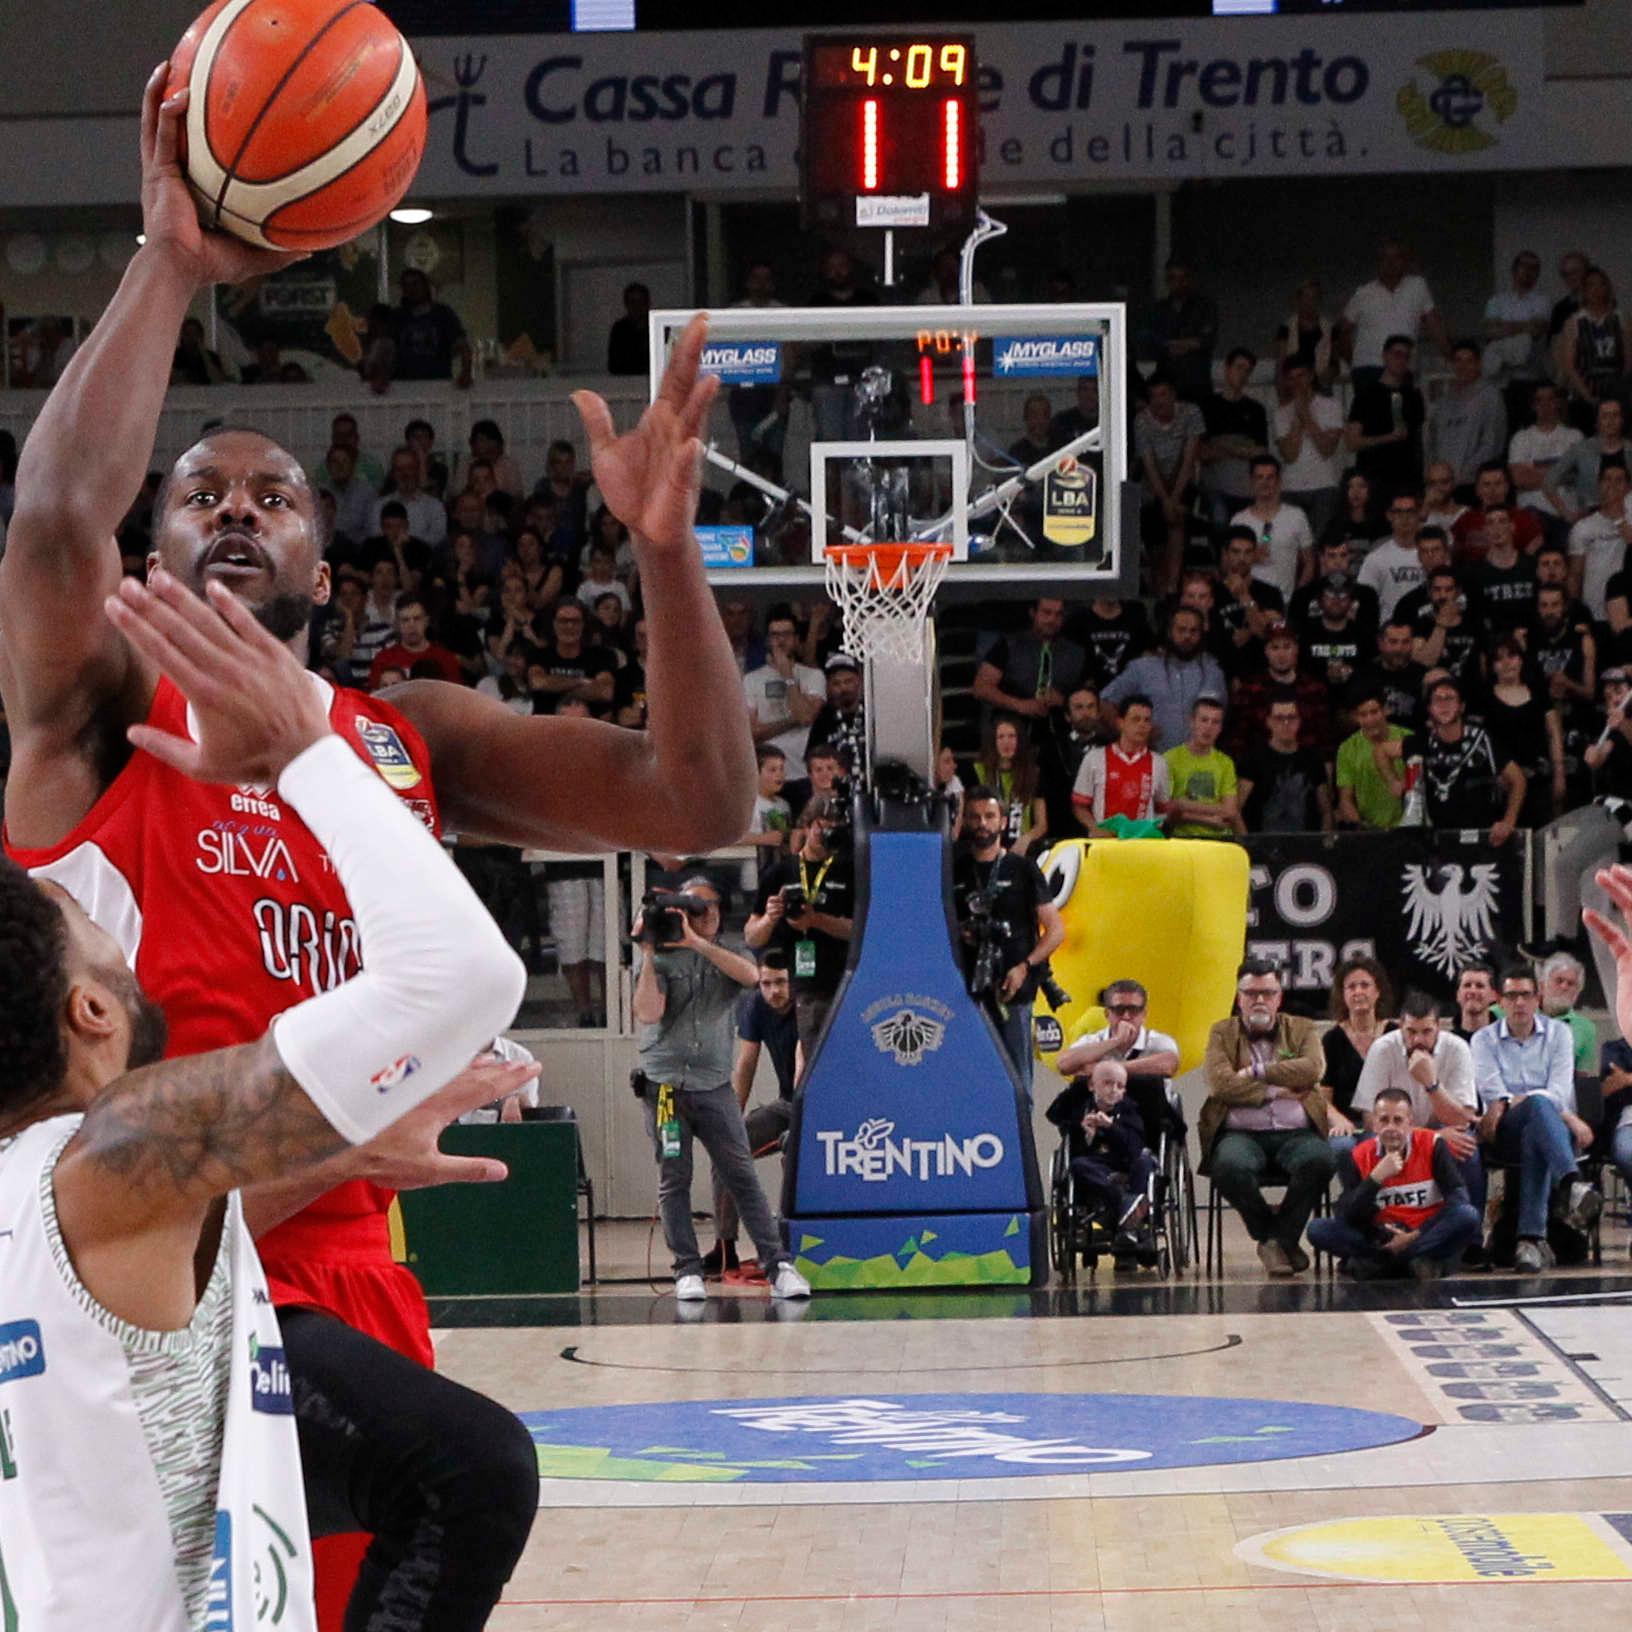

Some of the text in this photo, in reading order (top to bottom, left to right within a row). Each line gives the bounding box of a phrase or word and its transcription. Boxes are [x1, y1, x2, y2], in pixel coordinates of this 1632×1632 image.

[525, 54, 738, 125] Cassa
[852, 45, 966, 89] 4:09
[1029, 42, 1096, 112] di
[1124, 38, 1369, 110] Trento
[524, 138, 580, 178] La
[607, 136, 767, 176] banca
[864, 100, 959, 188] 11
[1050, 122, 1188, 166] della
[1013, 341, 1096, 358] MYGLASS
[196, 828, 300, 884] SILVA
[816, 1131, 1005, 1182] TRENTINO
[1377, 1191, 1427, 1206] TAFF
